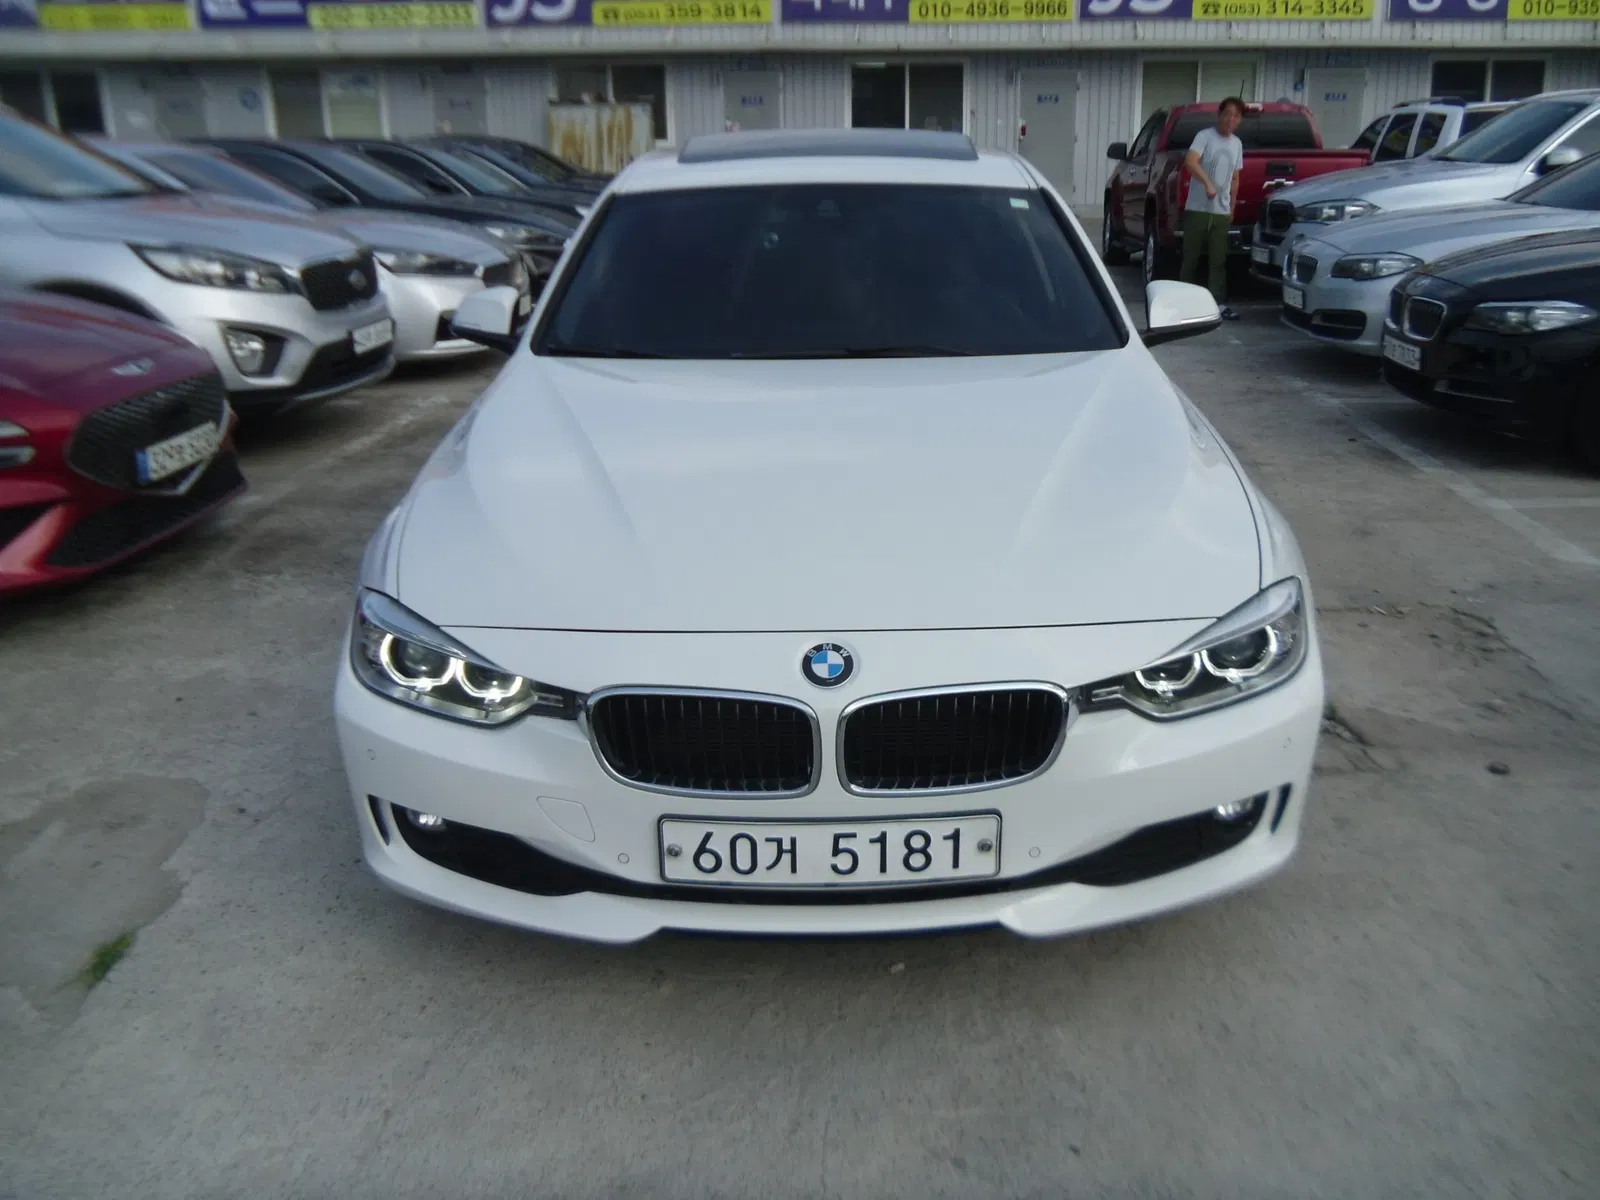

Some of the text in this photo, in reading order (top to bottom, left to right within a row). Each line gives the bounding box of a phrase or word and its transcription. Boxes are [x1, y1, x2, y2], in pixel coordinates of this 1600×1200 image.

[918, 0, 1068, 18] 010-4936-9966
[1224, 0, 1364, 15] (053) 314-3345
[806, 643, 850, 658] BMW
[693, 827, 961, 875] 60거 5181
